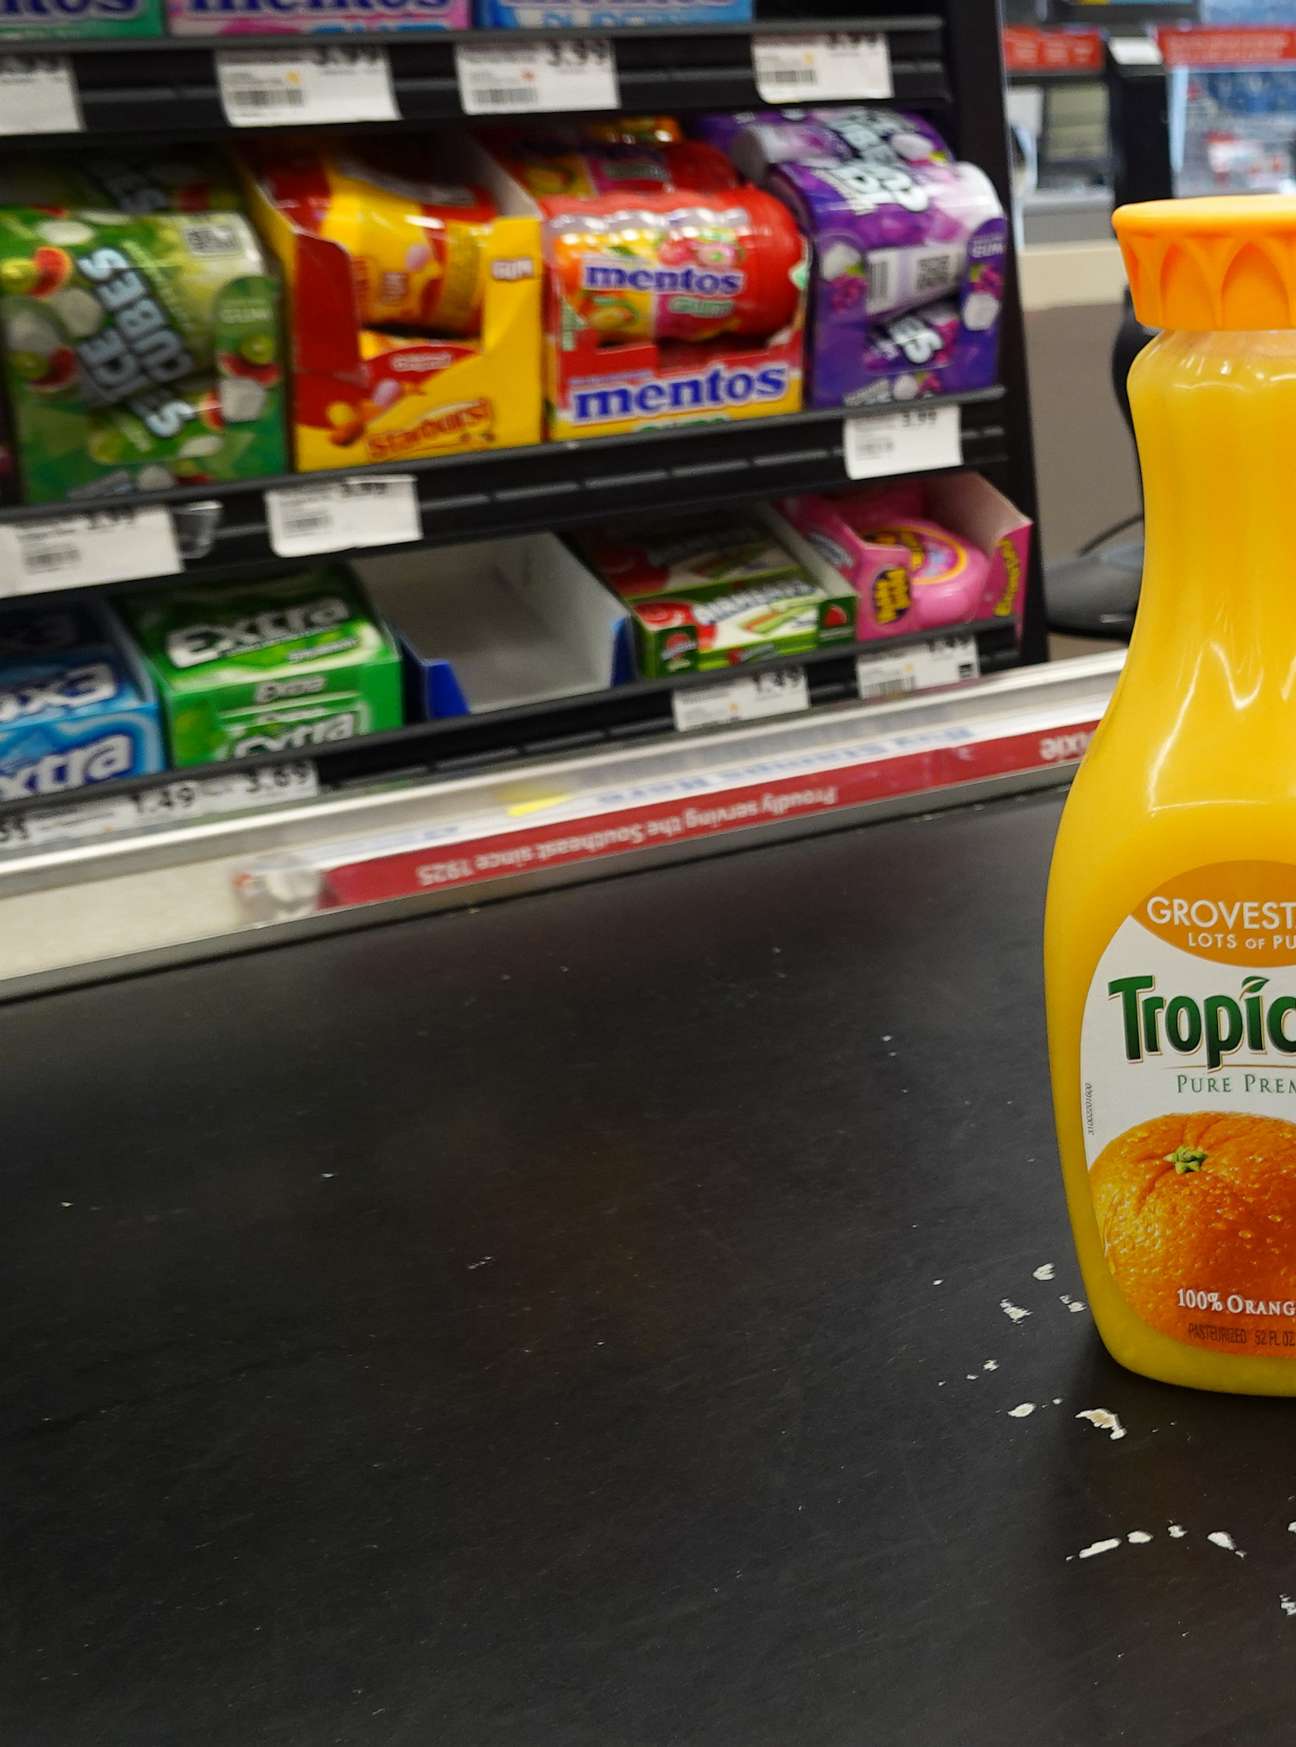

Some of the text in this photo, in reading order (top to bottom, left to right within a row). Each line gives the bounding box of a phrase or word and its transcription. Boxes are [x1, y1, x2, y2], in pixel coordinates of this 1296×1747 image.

[583, 265, 744, 294] mentos
[574, 366, 788, 420] mentos
[167, 598, 350, 668] Extra
[415, 786, 839, 888] Proudly serving the Southeast since 1925
[1188, 931, 1237, 949] LOTS
[1176, 1074, 1232, 1095] PURE
[1176, 1287, 1223, 1313] 100%
[1188, 1324, 1248, 1346] PASTEURIZED
[1254, 1330, 1267, 1346] 52
[1268, 1331, 1281, 1346] FL
[1282, 1331, 1296, 1347] OZ
